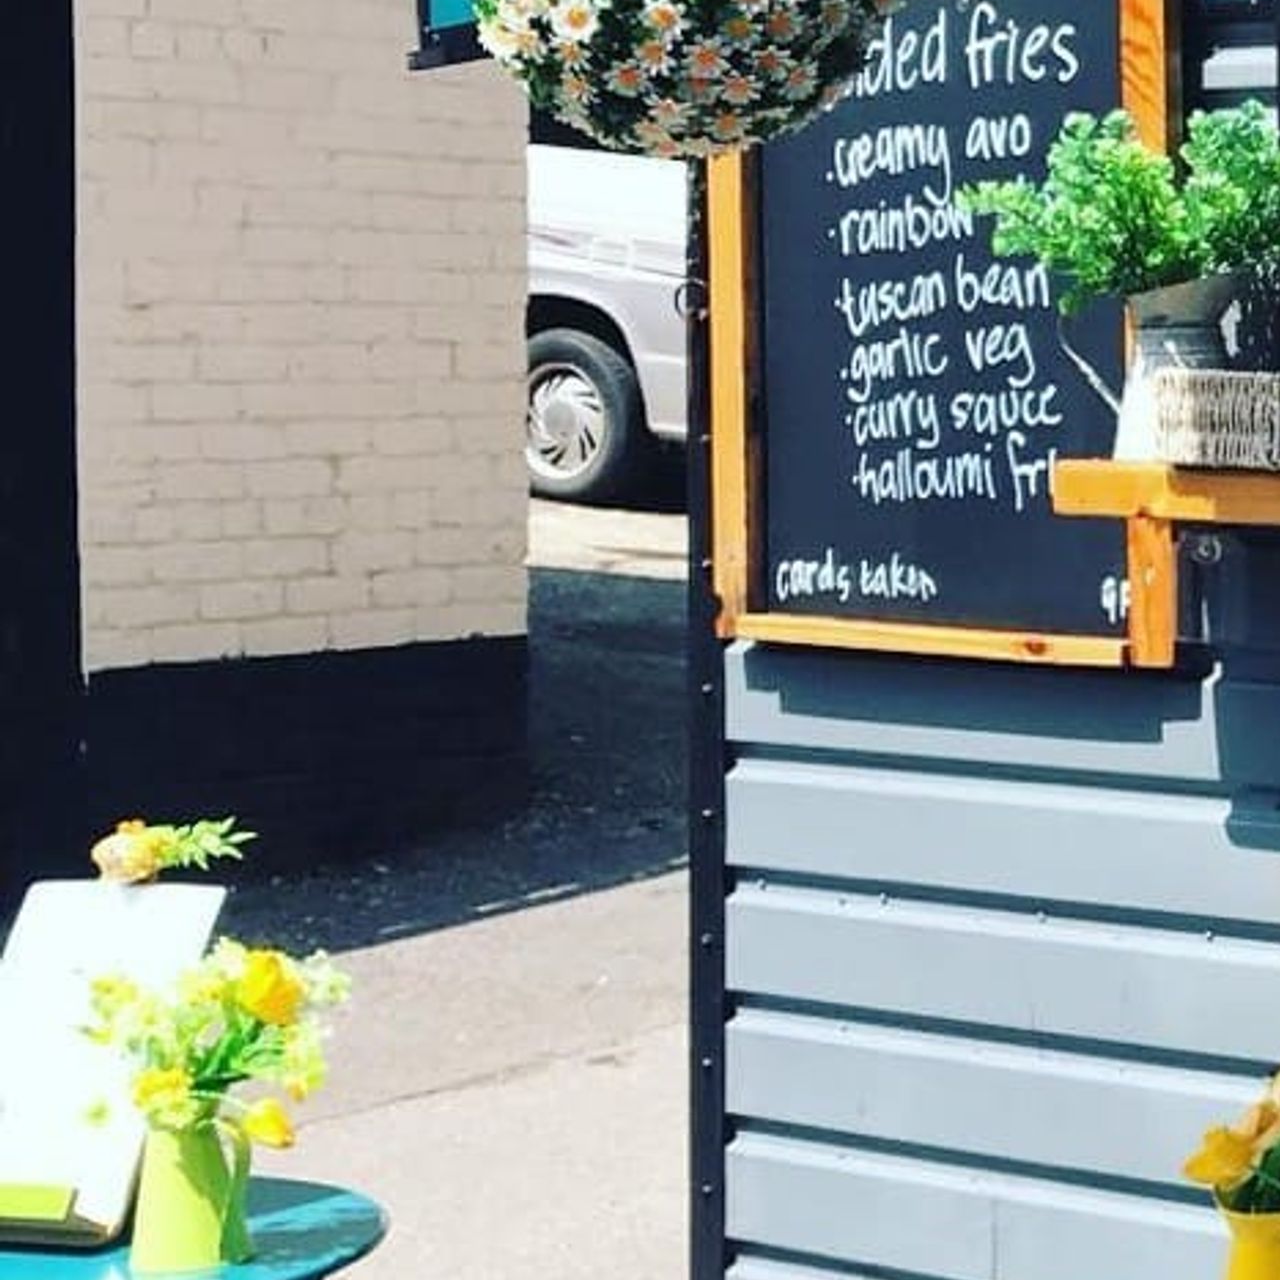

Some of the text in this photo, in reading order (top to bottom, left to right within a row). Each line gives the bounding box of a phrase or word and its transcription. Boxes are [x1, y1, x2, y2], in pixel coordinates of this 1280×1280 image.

[844, 1, 1079, 97] ded fries
[834, 113, 1031, 206] creamy avo
[841, 251, 1051, 337] tuscan bean
[847, 322, 1036, 403] garlic veg
[853, 384, 1063, 449] curry sauce
[857, 430, 1057, 513] halloumi fri
[777, 548, 938, 602] cards taken
